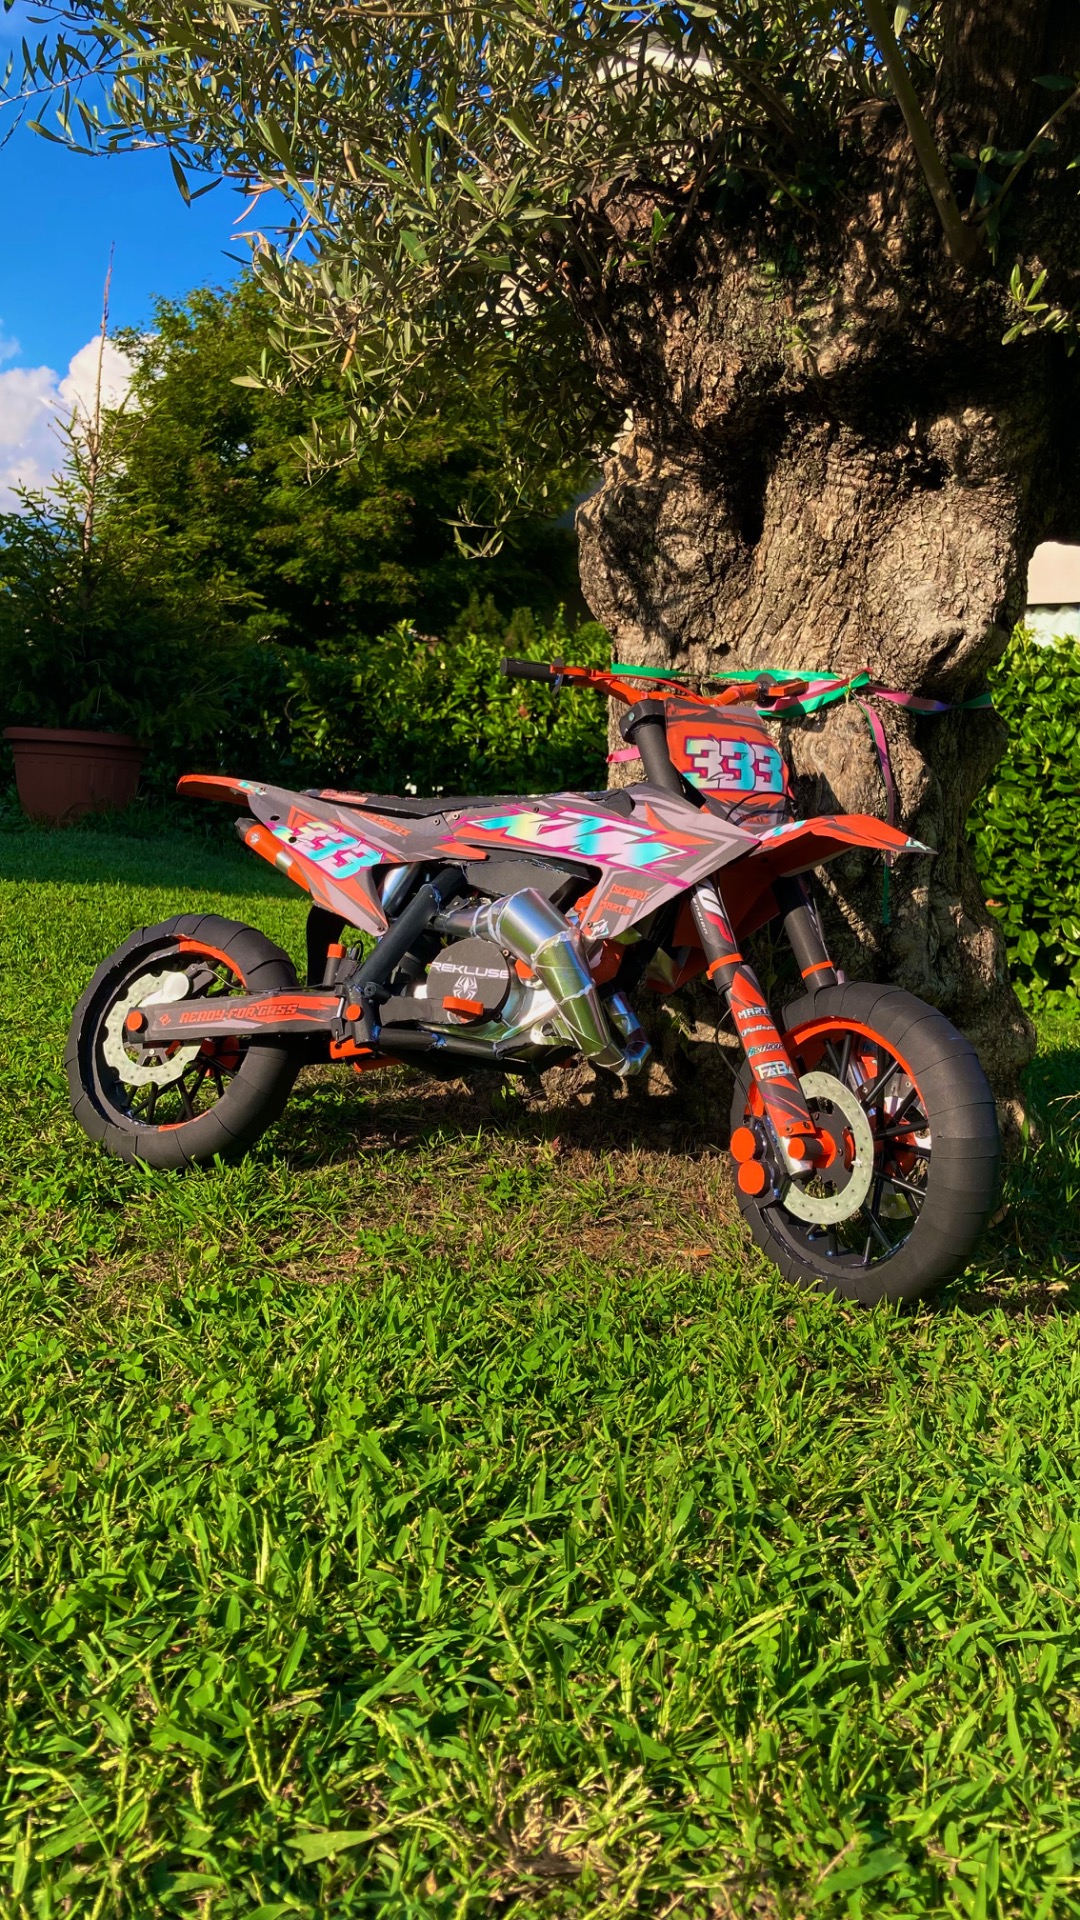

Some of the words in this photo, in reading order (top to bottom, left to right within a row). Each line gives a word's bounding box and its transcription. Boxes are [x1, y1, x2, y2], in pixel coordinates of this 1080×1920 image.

[682, 738, 784, 793] 333
[271, 821, 383, 879] 333
[466, 809, 688, 867] KTM
[431, 961, 510, 979] REKLUSE
